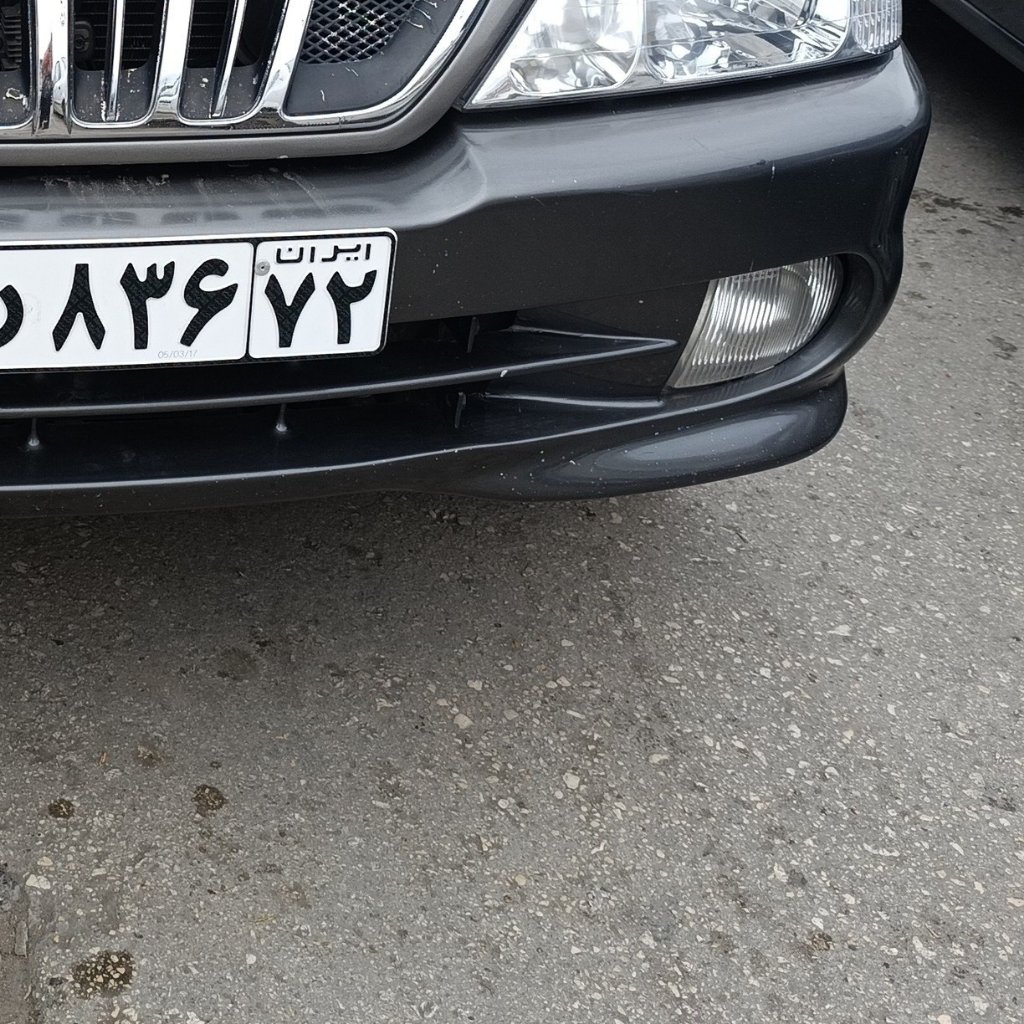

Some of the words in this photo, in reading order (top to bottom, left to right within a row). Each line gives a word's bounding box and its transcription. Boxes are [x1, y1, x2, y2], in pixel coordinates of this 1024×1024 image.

[276, 243, 372, 264] ایران
[52, 258, 239, 351] ۸۳۶
[264, 269, 378, 348] ۷۲
